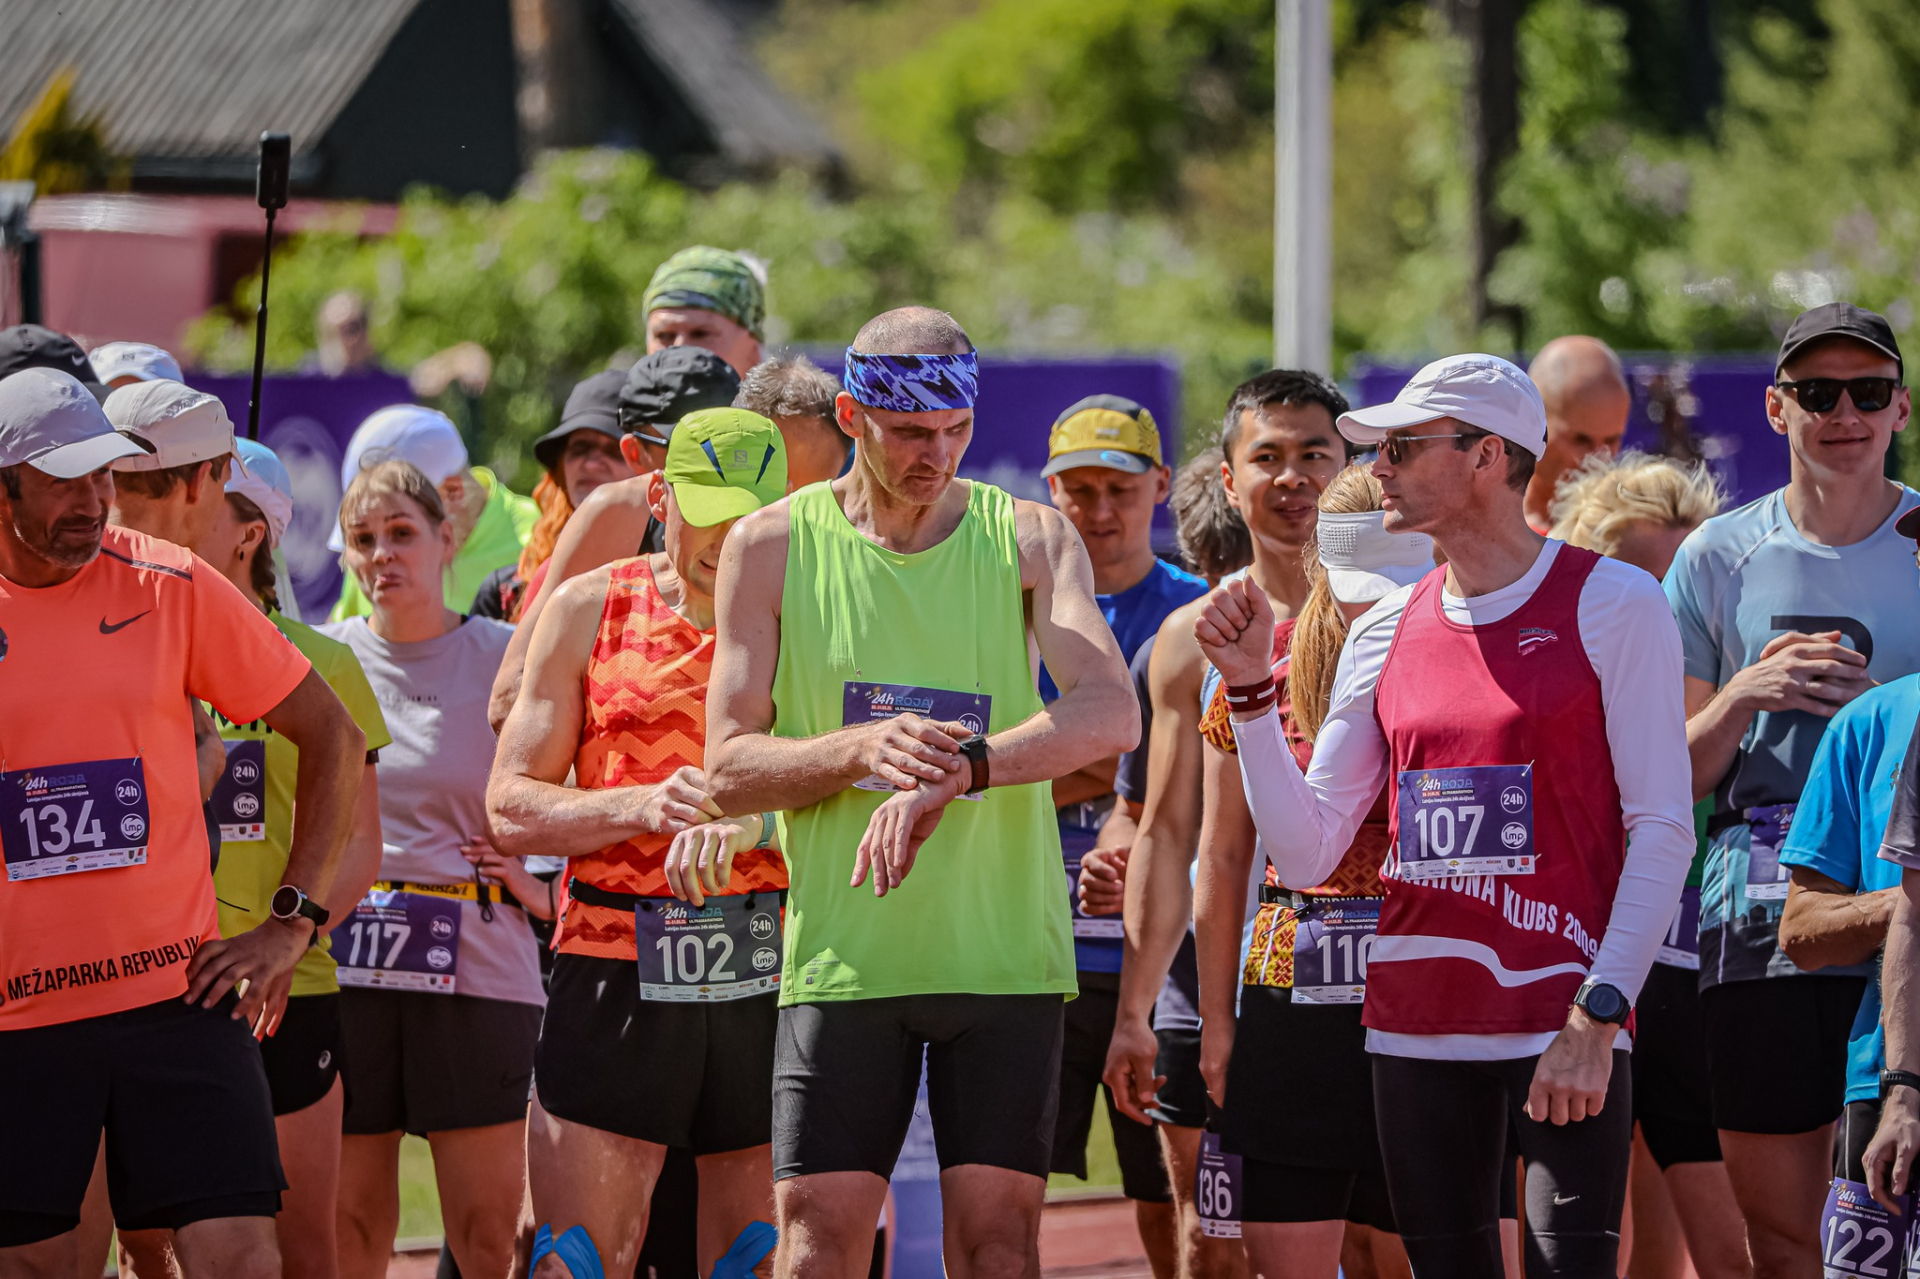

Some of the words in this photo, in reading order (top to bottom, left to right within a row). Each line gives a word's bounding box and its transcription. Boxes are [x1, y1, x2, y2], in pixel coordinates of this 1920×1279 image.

[235, 765, 256, 778] 24h
[25, 776, 48, 790] 24h
[1421, 778, 1441, 791] 24h
[118, 786, 138, 798] 24h
[236, 800, 256, 811] lmp
[1503, 793, 1523, 805] 24h
[20, 799, 107, 857] 134
[124, 822, 143, 834] lmp
[1415, 805, 1485, 858] 107
[1504, 830, 1524, 842] lmp
[664, 907, 687, 919] 24h
[752, 920, 772, 932] 24h
[1503, 882, 1558, 934] KLUBS
[1562, 911, 1598, 961] 2009
[348, 922, 411, 969] 117
[656, 933, 736, 983] 102
[756, 956, 775, 965] lmp
[7, 958, 119, 1001] MEŽAPARKA
[1199, 1168, 1232, 1217] 136
[1838, 1190, 1856, 1203] 24h
[1824, 1215, 1894, 1277] 122
